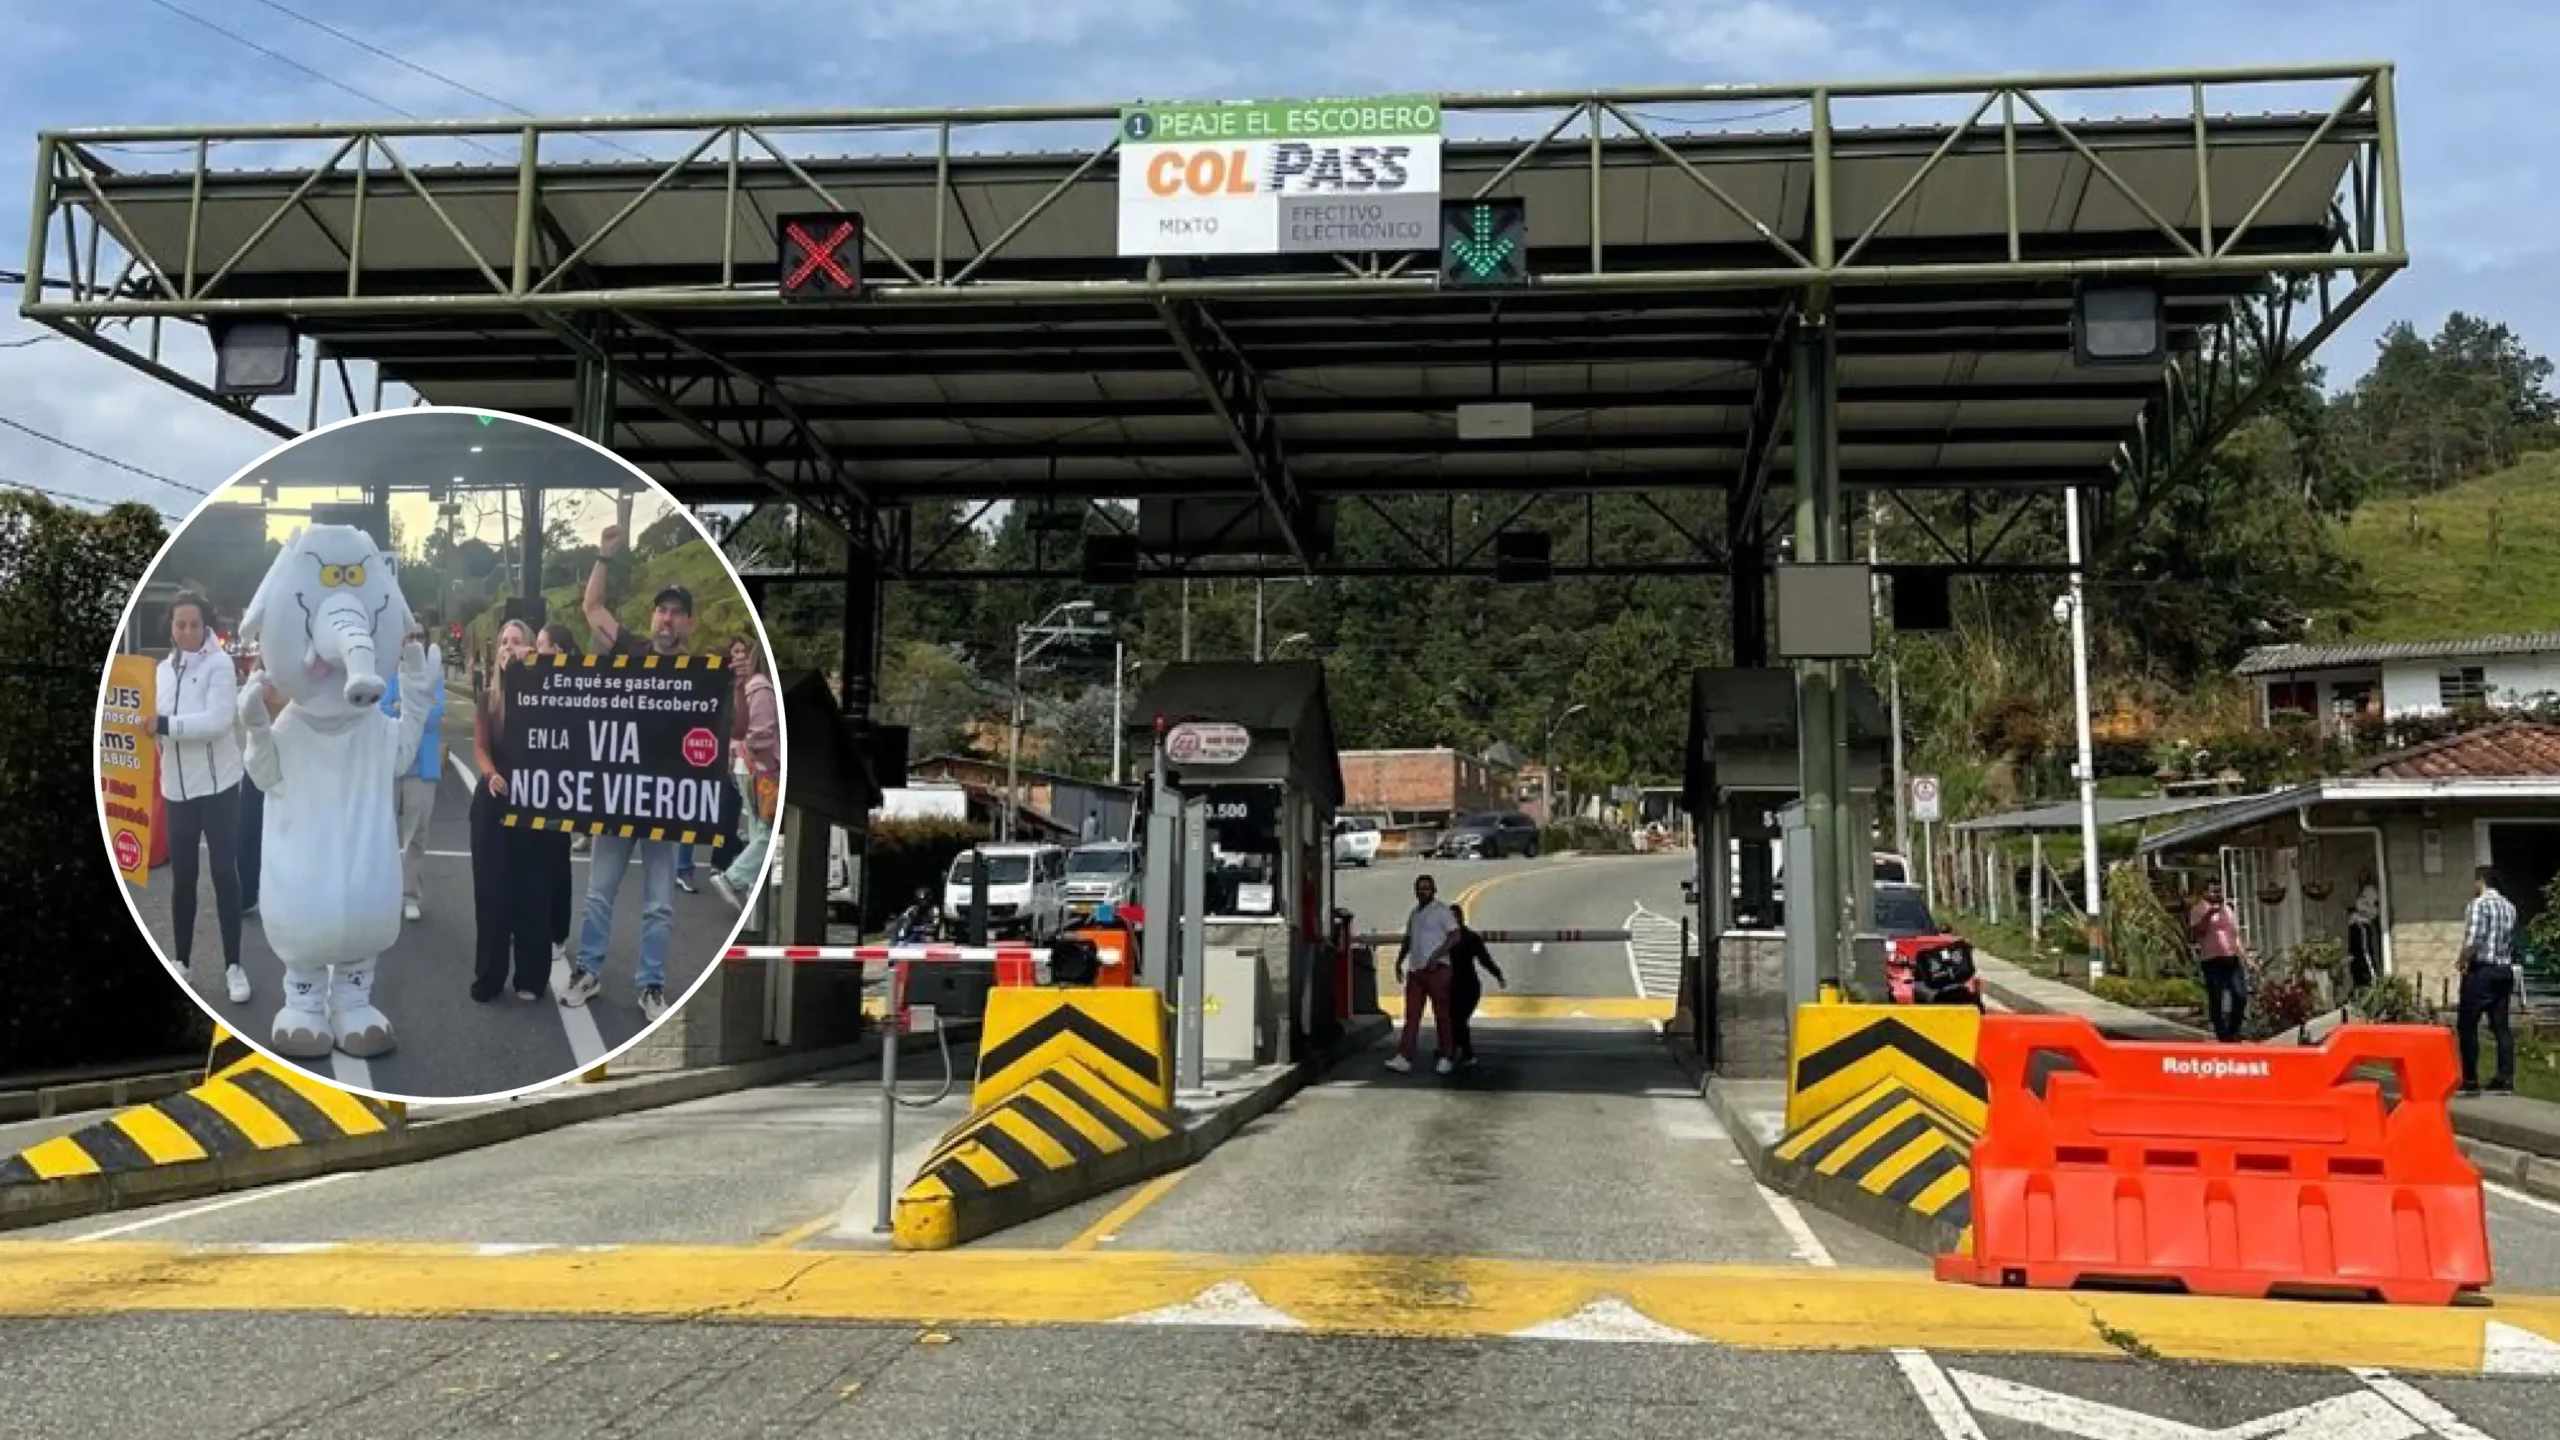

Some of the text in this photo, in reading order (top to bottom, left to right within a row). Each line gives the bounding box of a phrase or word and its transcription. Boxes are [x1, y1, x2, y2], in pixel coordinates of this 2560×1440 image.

[1133, 105, 1436, 137] 1 PEAJE EL ESCOBERO
[1146, 149, 1256, 196] COL
[1291, 204, 1382, 222] EFECTIVO
[1159, 216, 1219, 236] MIXTO
[574, 673, 602, 691] qué
[604, 677, 622, 689] se
[624, 676, 693, 693] gastaron
[517, 691, 719, 713] los recaudos del Escobero?
[127, 712, 142, 725] de
[528, 720, 641, 764] EN LA VIA
[103, 752, 141, 770] ABUSO
[510, 768, 722, 825] NO SE VIERON
[2162, 1057, 2269, 1079] Rotoplast
